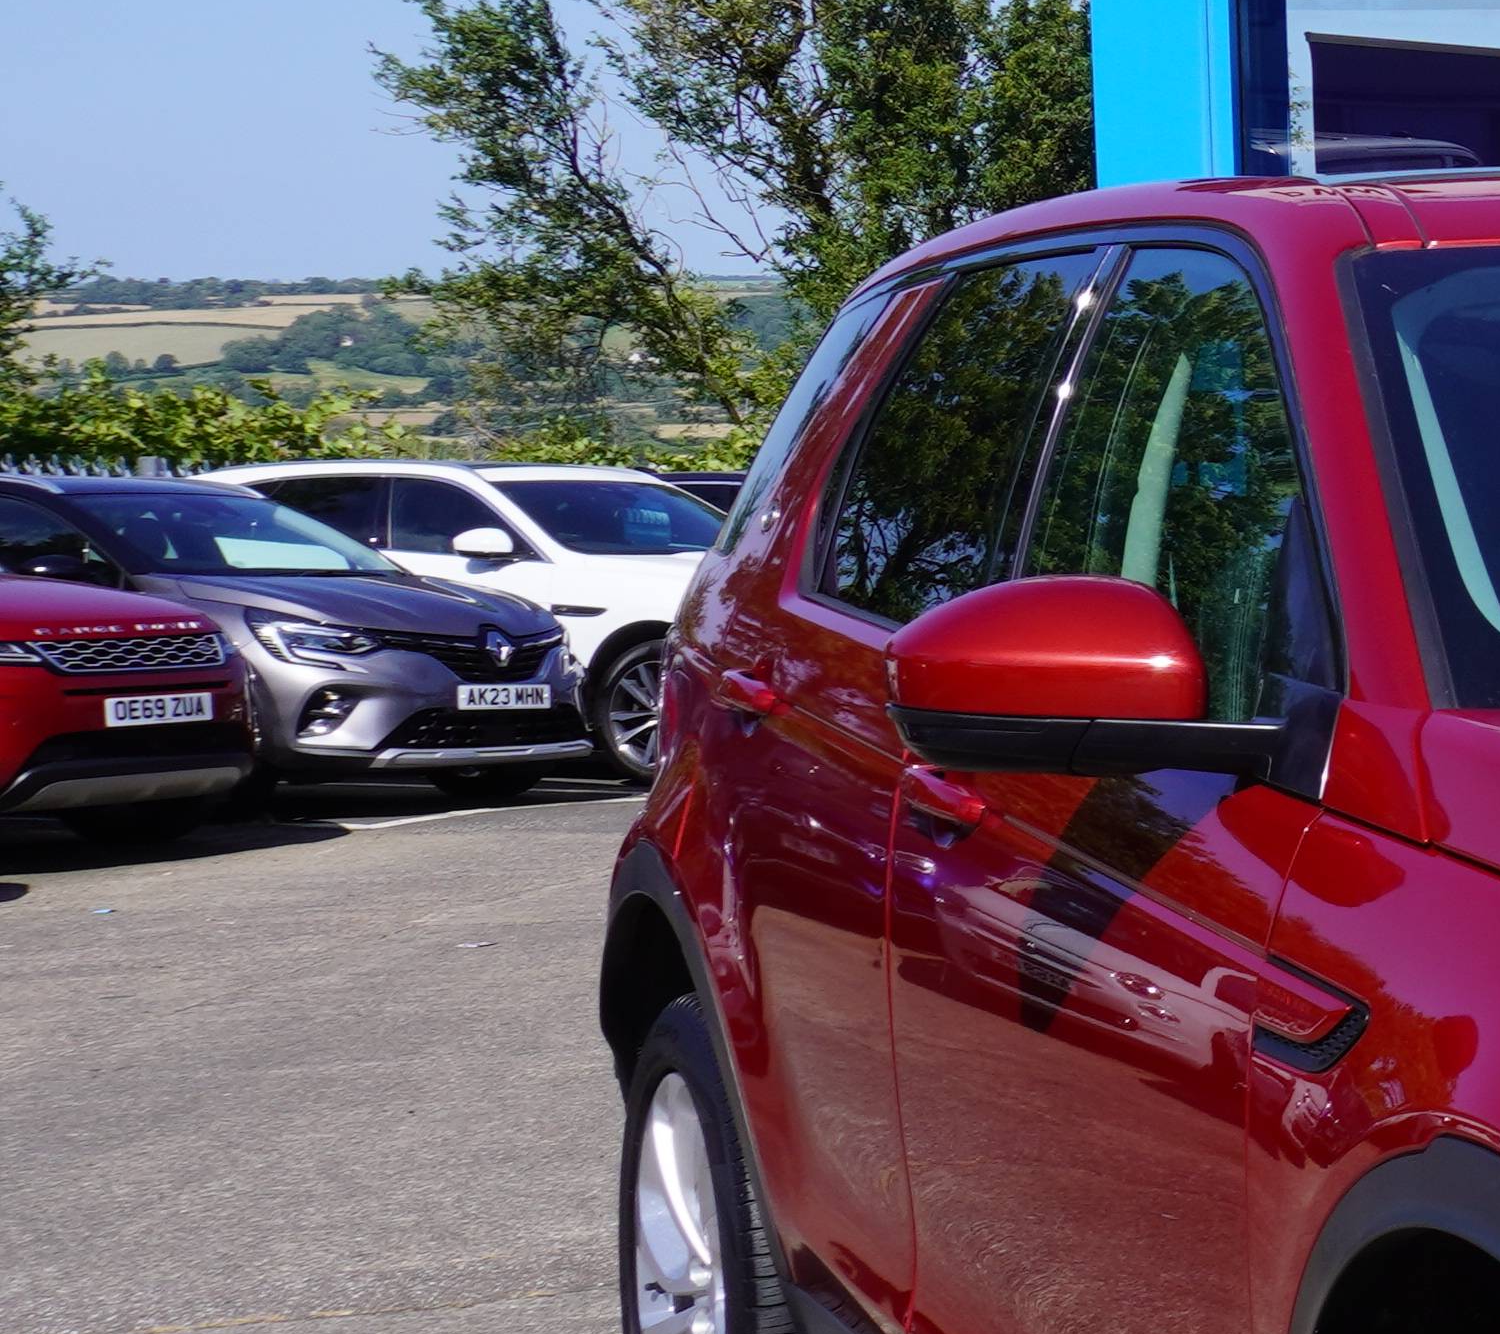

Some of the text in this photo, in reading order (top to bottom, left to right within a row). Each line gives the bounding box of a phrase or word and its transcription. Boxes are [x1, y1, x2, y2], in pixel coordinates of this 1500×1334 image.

[467, 687, 544, 706] AK23 MHN
[114, 697, 206, 721] OE69 ZUA
